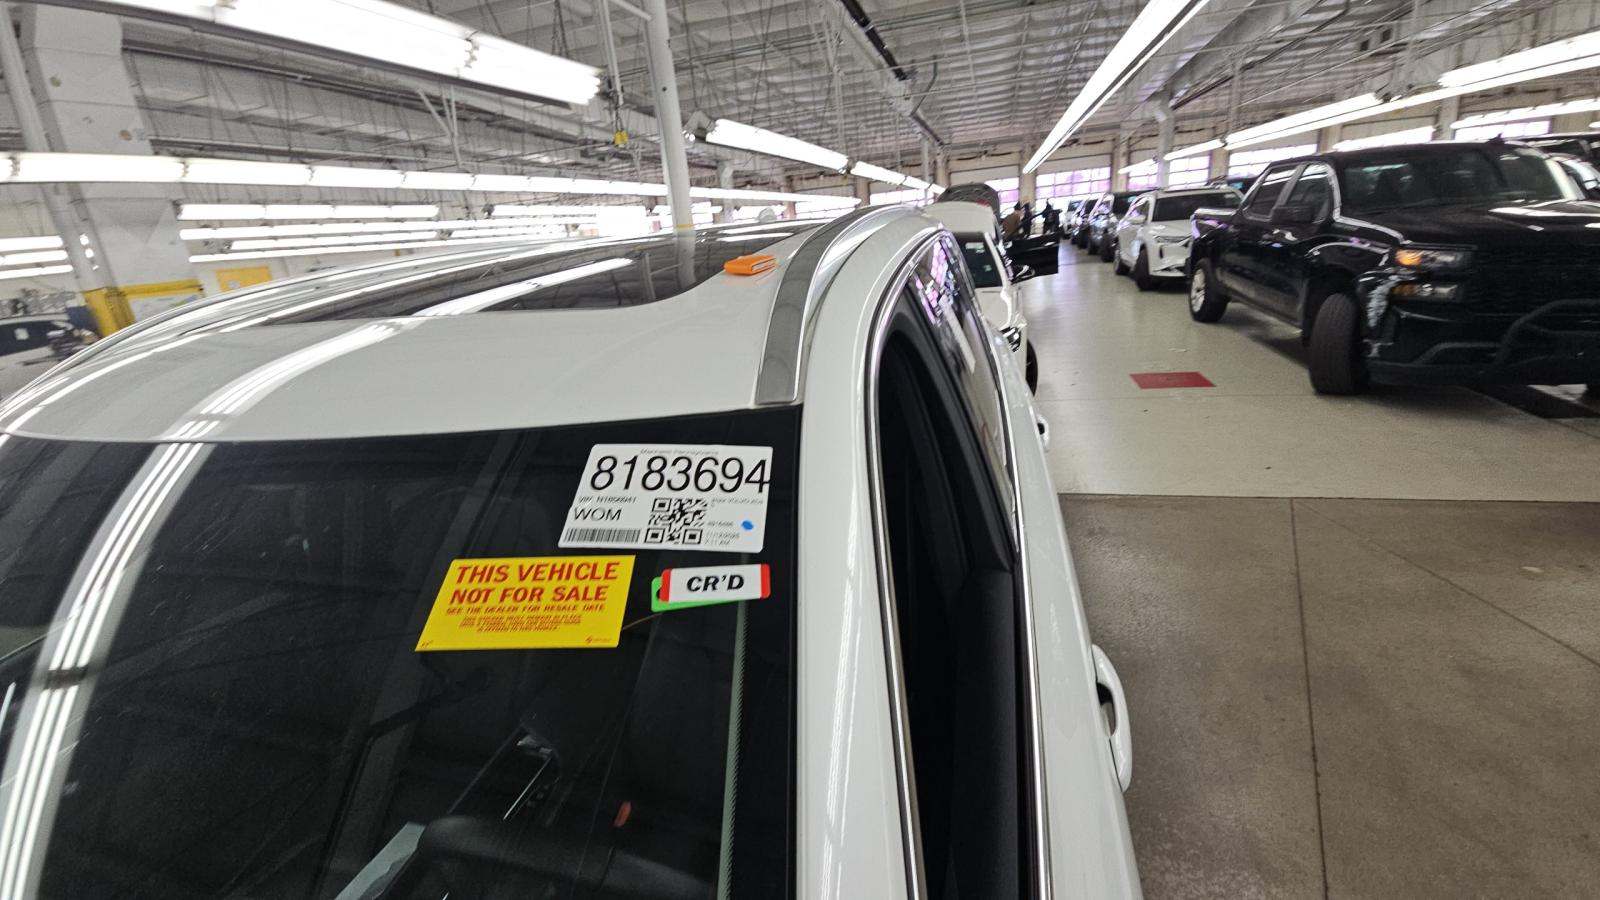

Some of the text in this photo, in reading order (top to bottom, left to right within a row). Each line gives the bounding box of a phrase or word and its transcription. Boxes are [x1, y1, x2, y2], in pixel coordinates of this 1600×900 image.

[591, 455, 771, 494] 8183694
[574, 507, 622, 521] WOM
[455, 562, 620, 584] THIS VEHICLE
[686, 574, 744, 592] CR'D
[449, 585, 609, 605] NOT FOR SALE
[467, 607, 481, 615] THE
[484, 606, 519, 614] DEALER
[522, 605, 541, 613] FOR
[543, 604, 577, 612] RESALE
[582, 604, 605, 612] DATE
